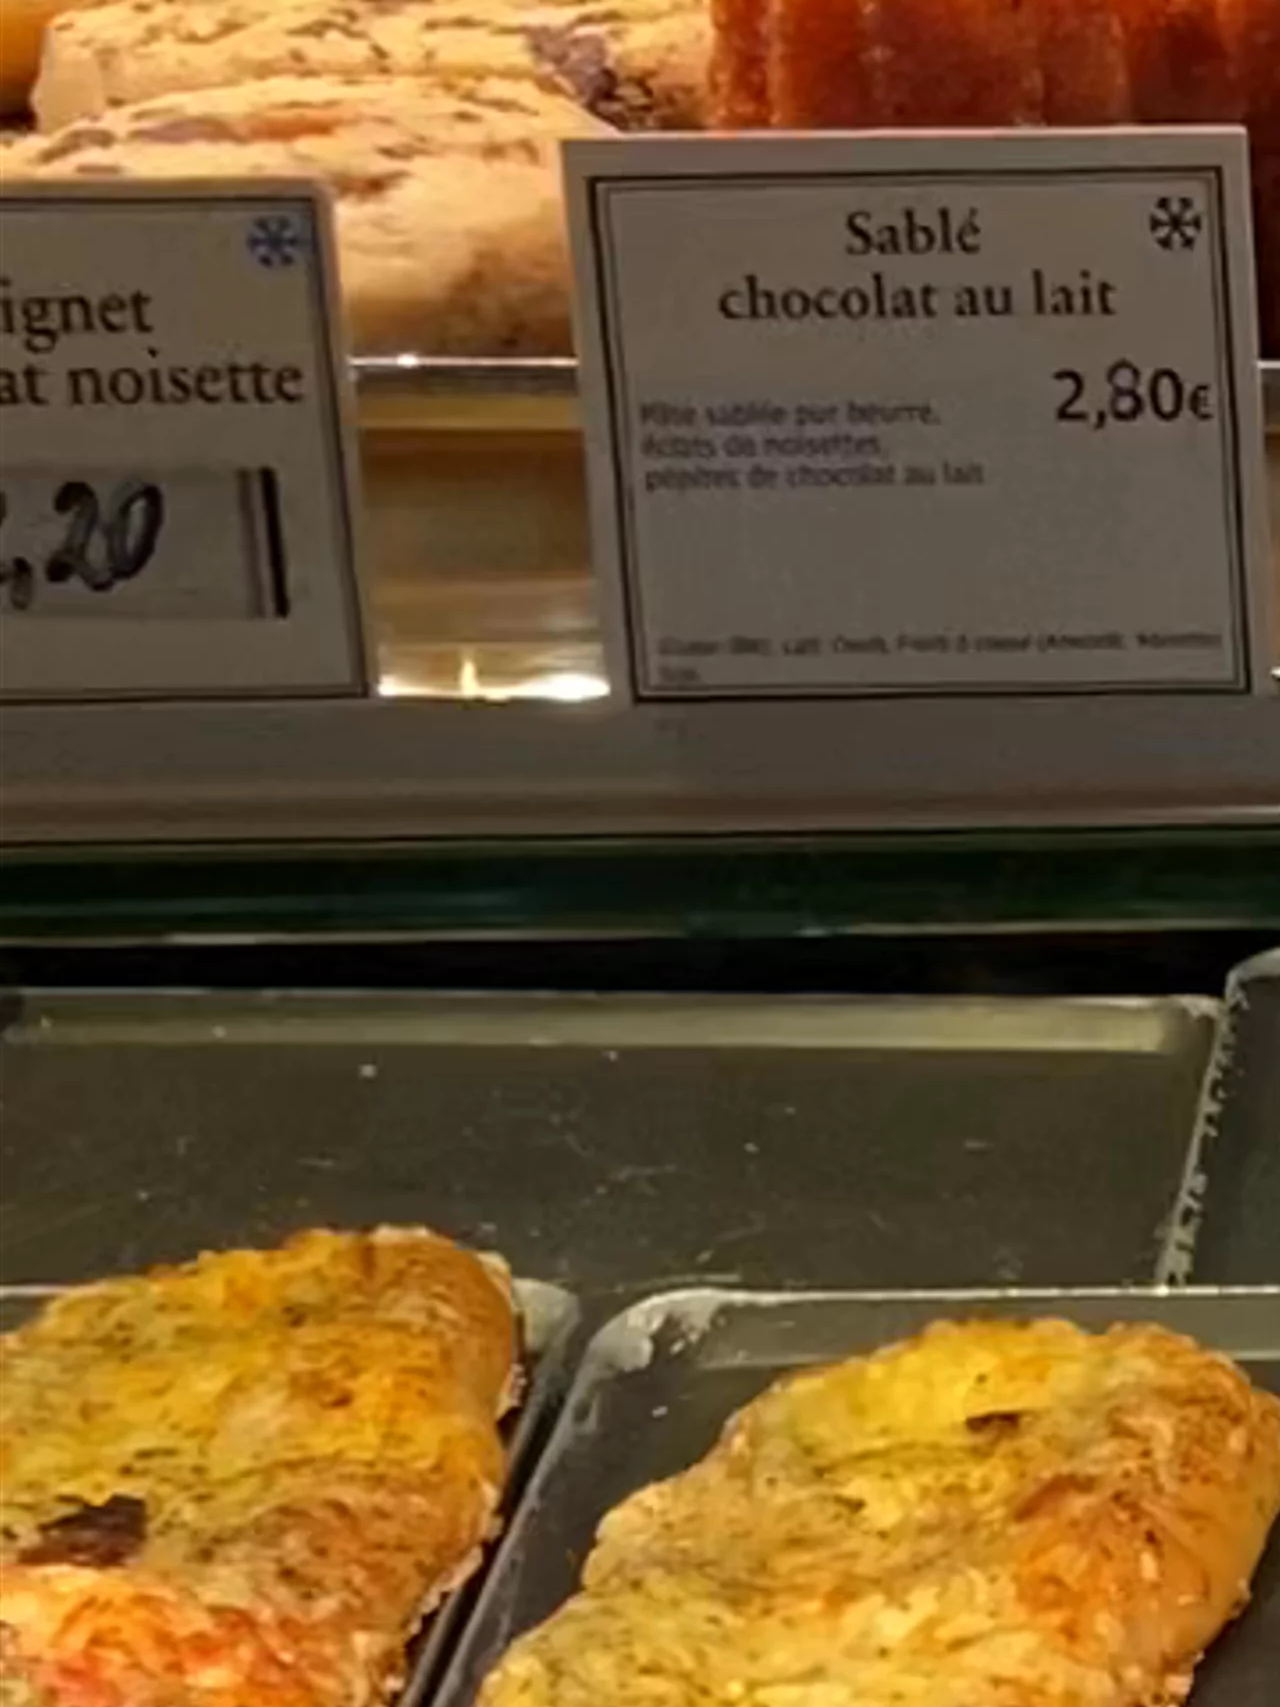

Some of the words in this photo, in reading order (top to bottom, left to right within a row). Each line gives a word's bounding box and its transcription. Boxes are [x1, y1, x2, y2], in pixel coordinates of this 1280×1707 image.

[845, 207, 983, 257] Sablé
[718, 273, 939, 321] chocolat
[954, 286, 1014, 317] au
[1031, 269, 1117, 317] lait
[66, 348, 304, 407] noisette
[1053, 359, 1215, 430] 2,80€
